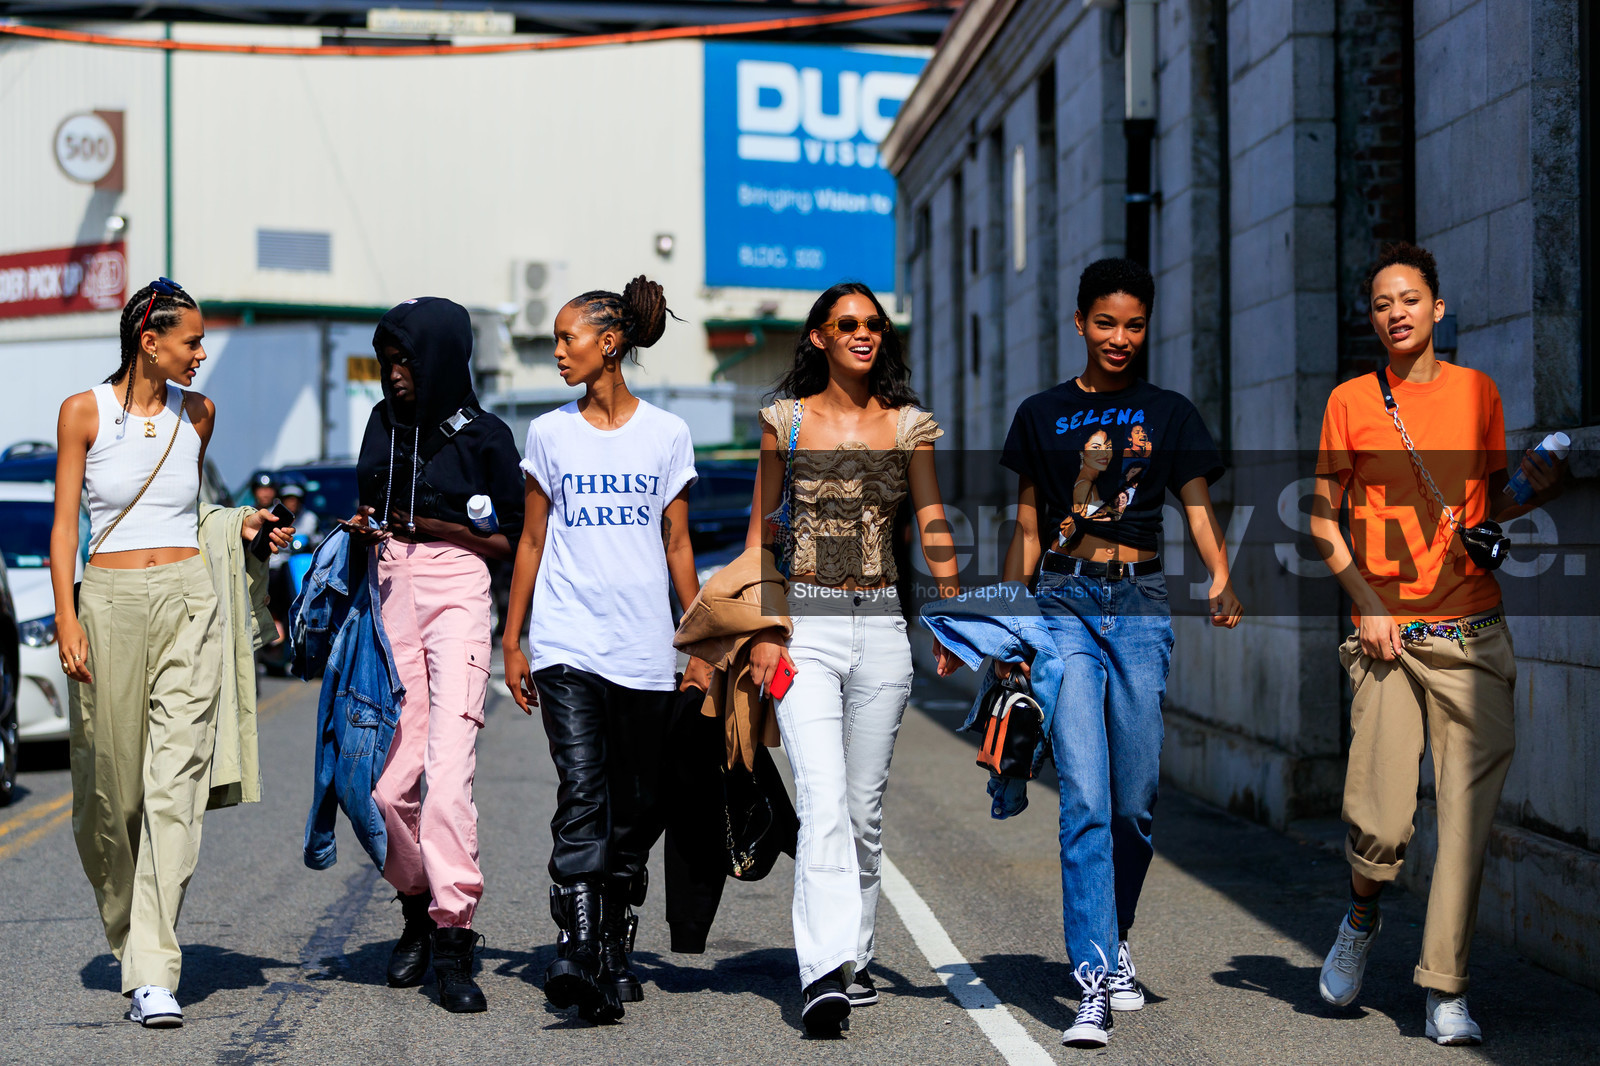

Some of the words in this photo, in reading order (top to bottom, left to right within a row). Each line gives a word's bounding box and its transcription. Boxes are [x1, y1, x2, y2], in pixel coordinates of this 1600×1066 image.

[65, 134, 109, 162] 500
[804, 138, 887, 169] VISU
[815, 188, 868, 213] Vision
[871, 192, 893, 215] to
[1055, 407, 1145, 435] SELENA
[562, 473, 660, 497] CHRIST
[562, 504, 651, 528] CARES
